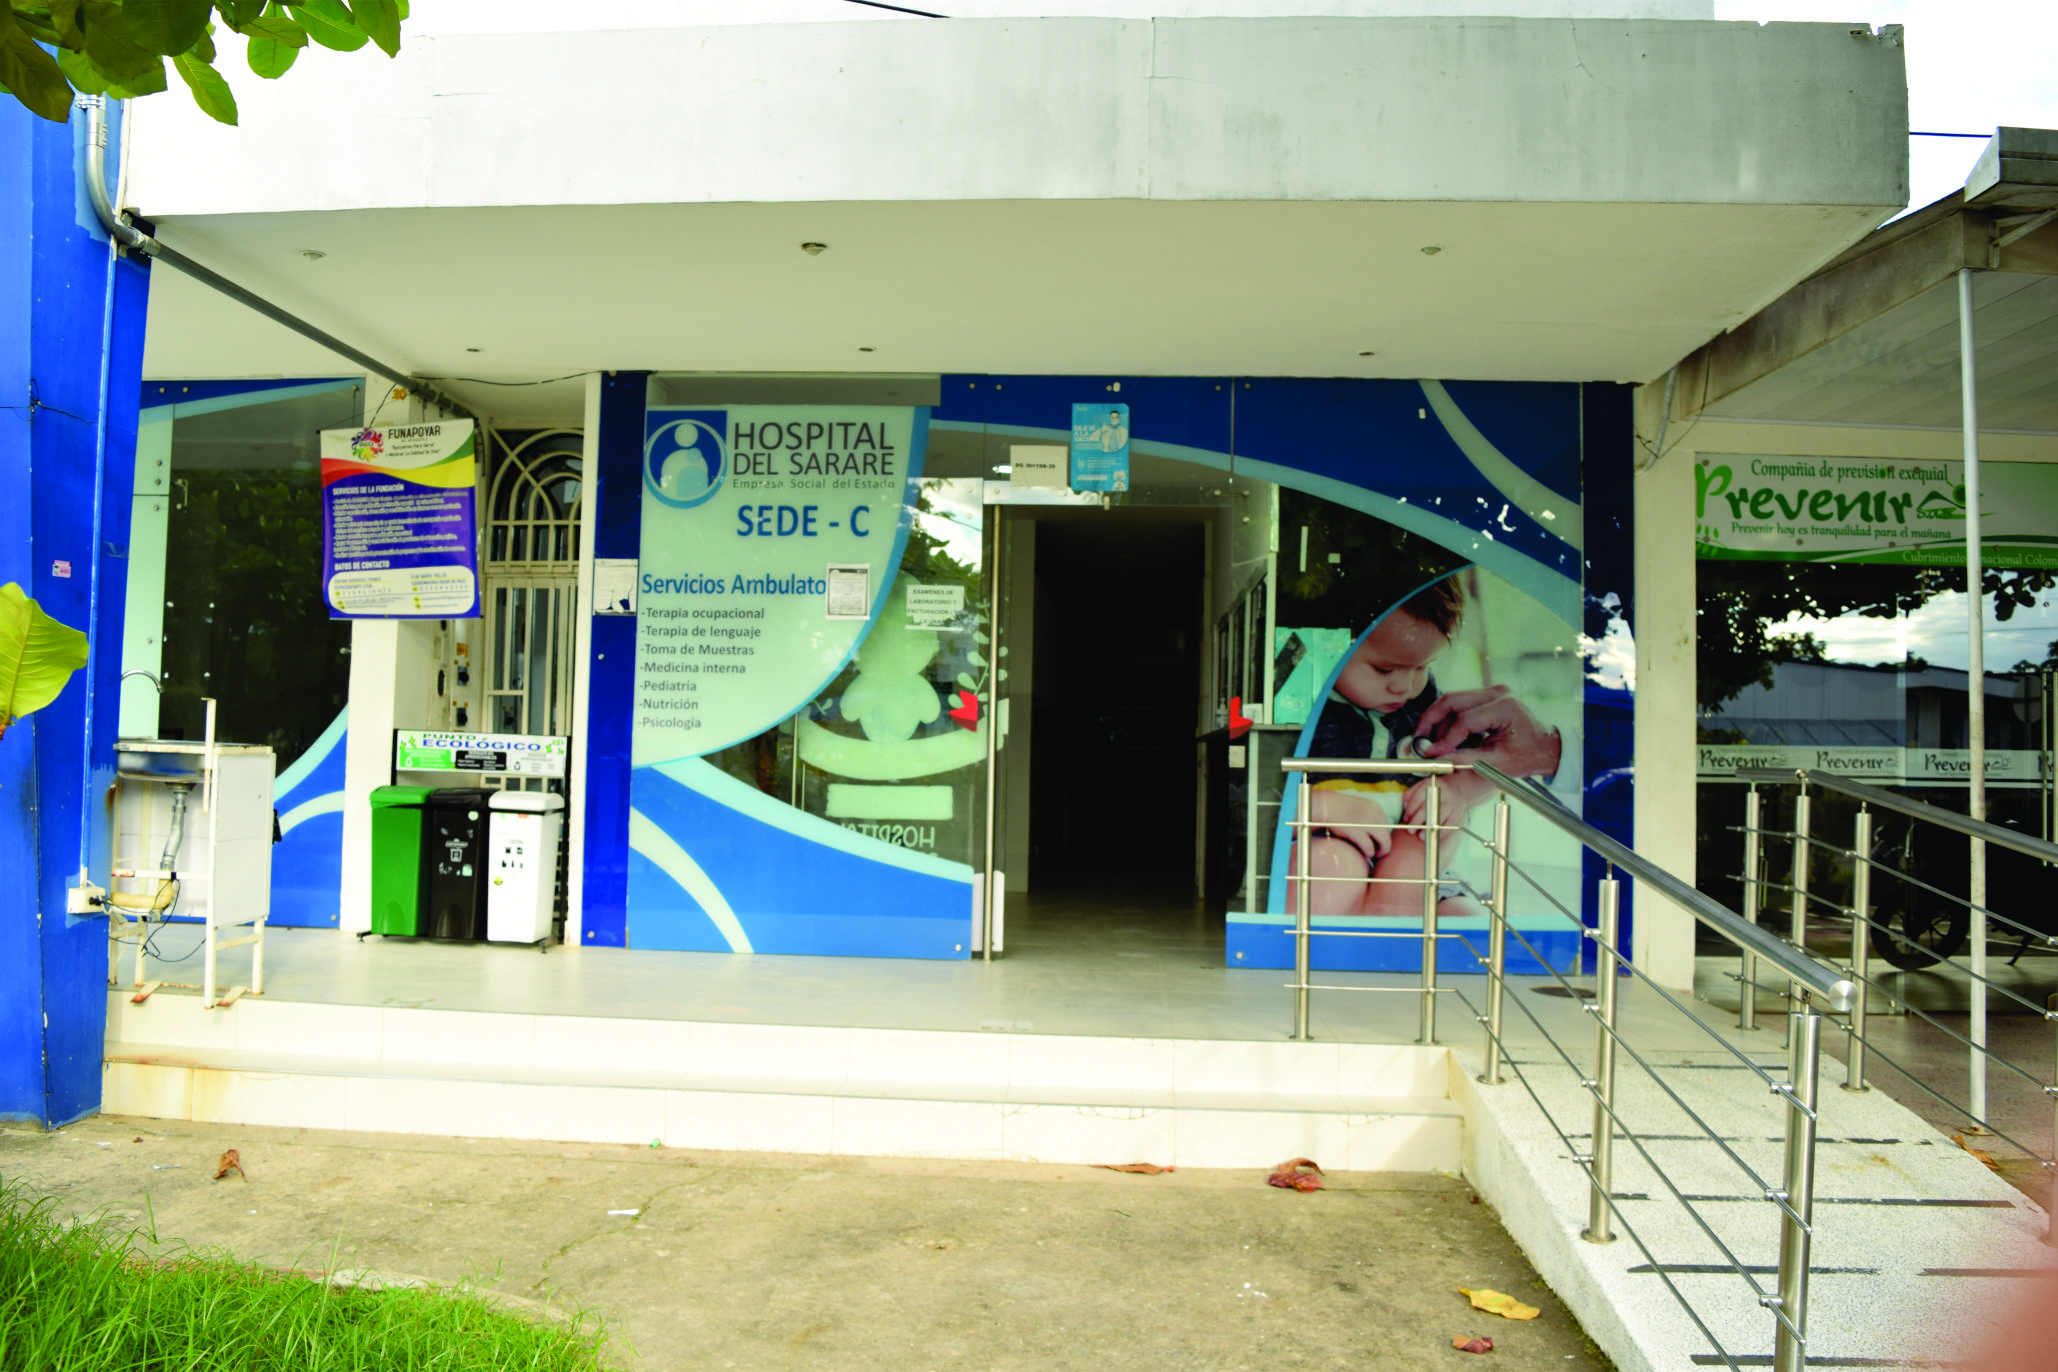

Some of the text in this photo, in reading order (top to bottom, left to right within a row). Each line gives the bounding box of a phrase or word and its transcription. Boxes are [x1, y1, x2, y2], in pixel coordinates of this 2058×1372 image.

[388, 425, 441, 439] FUNAPOYAR
[734, 422, 894, 450] HOSPITAL
[734, 453, 894, 475] DEL SARARE
[1820, 461, 1834, 478] de
[1898, 463, 1949, 486] exequial
[733, 479, 895, 490] Empresa Social del Estado
[1694, 462, 1914, 524] Prevenir
[737, 505, 818, 537] SEDE
[851, 505, 870, 537] C
[1731, 521, 1951, 541] Prevenir hoy es tranquilidad para el mañana
[1903, 551, 1967, 565] Cubrimiento
[641, 573, 725, 594] Servicios
[731, 573, 827, 595] Ambulato
[692, 608, 765, 622] ocupacional
[691, 626, 706, 637] de
[710, 626, 761, 640] lenguaje
[680, 644, 695, 655] de
[699, 645, 755, 656] Muestras
[702, 663, 746, 674] interna
[422, 733, 477, 741] PUNTO
[422, 737, 541, 751] ECOLÓGICO
[1700, 749, 1768, 768] Prevenir
[1816, 751, 1886, 770] Prevenir
[1924, 753, 1990, 772] Prever
